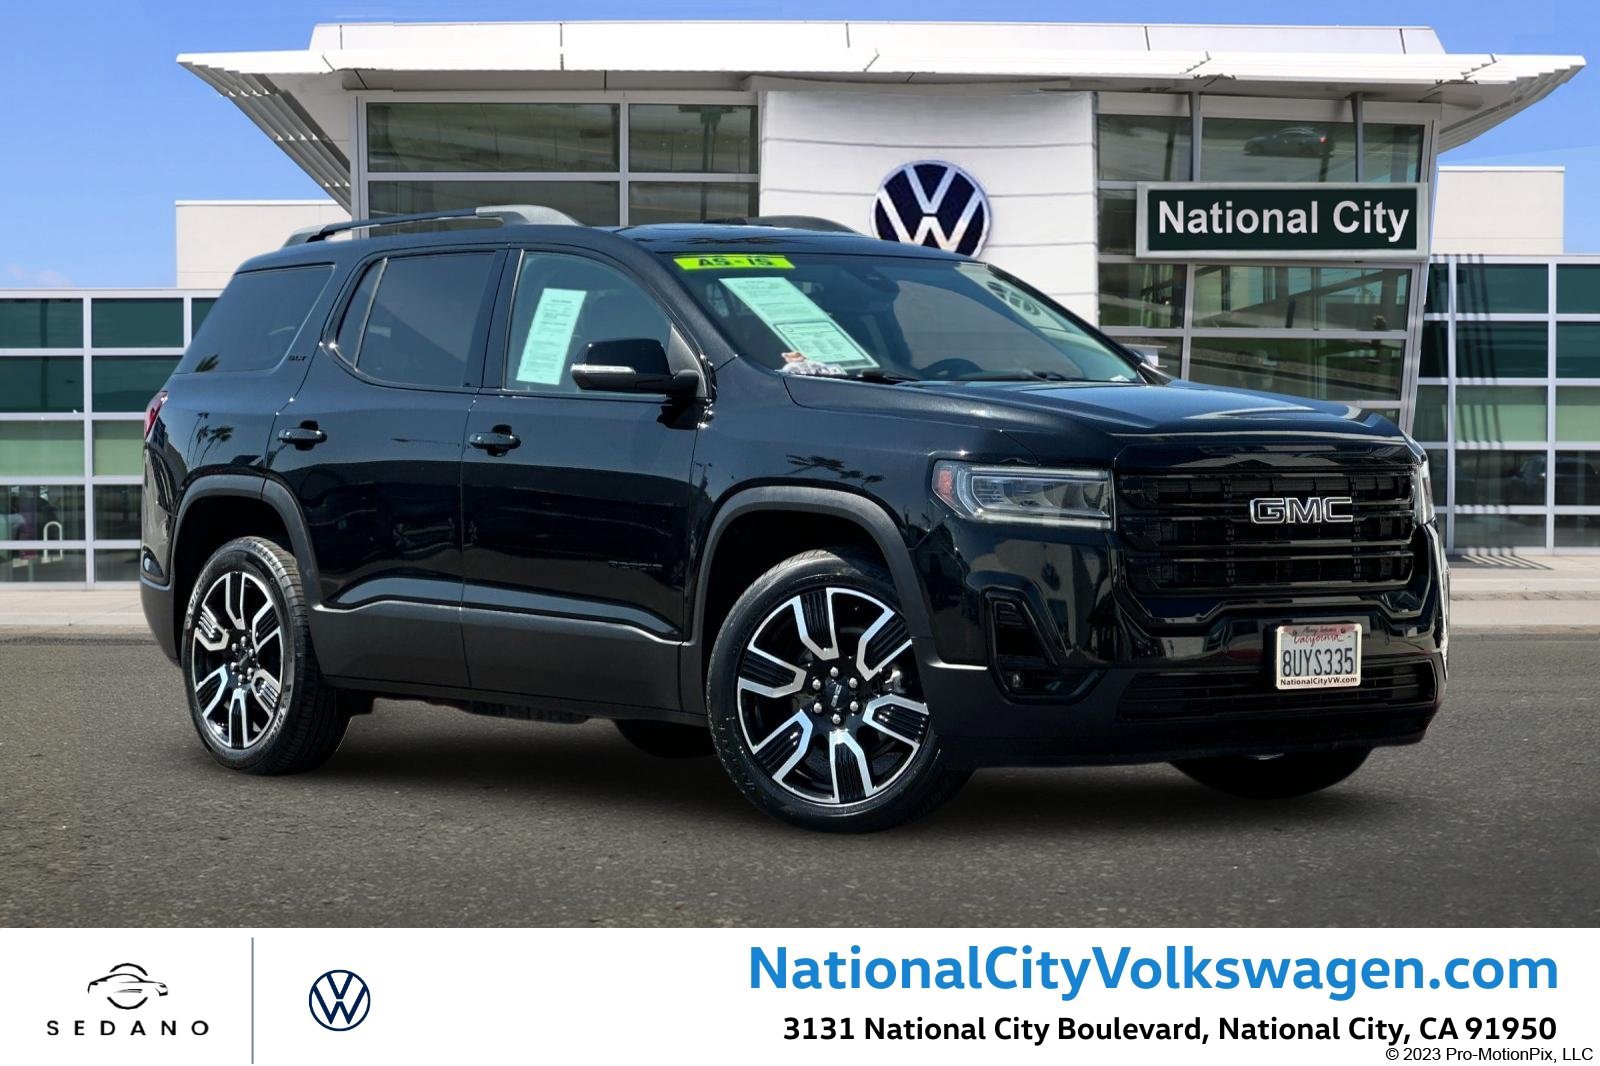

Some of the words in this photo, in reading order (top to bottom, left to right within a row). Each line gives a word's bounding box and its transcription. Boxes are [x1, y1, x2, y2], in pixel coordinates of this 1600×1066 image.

[1159, 200, 1318, 234] National
[1333, 200, 1410, 243] City
[1250, 497, 1354, 524] GMC
[1283, 648, 1354, 677] 8UYS335
[1281, 677, 1357, 687] NationalCityVW.com
